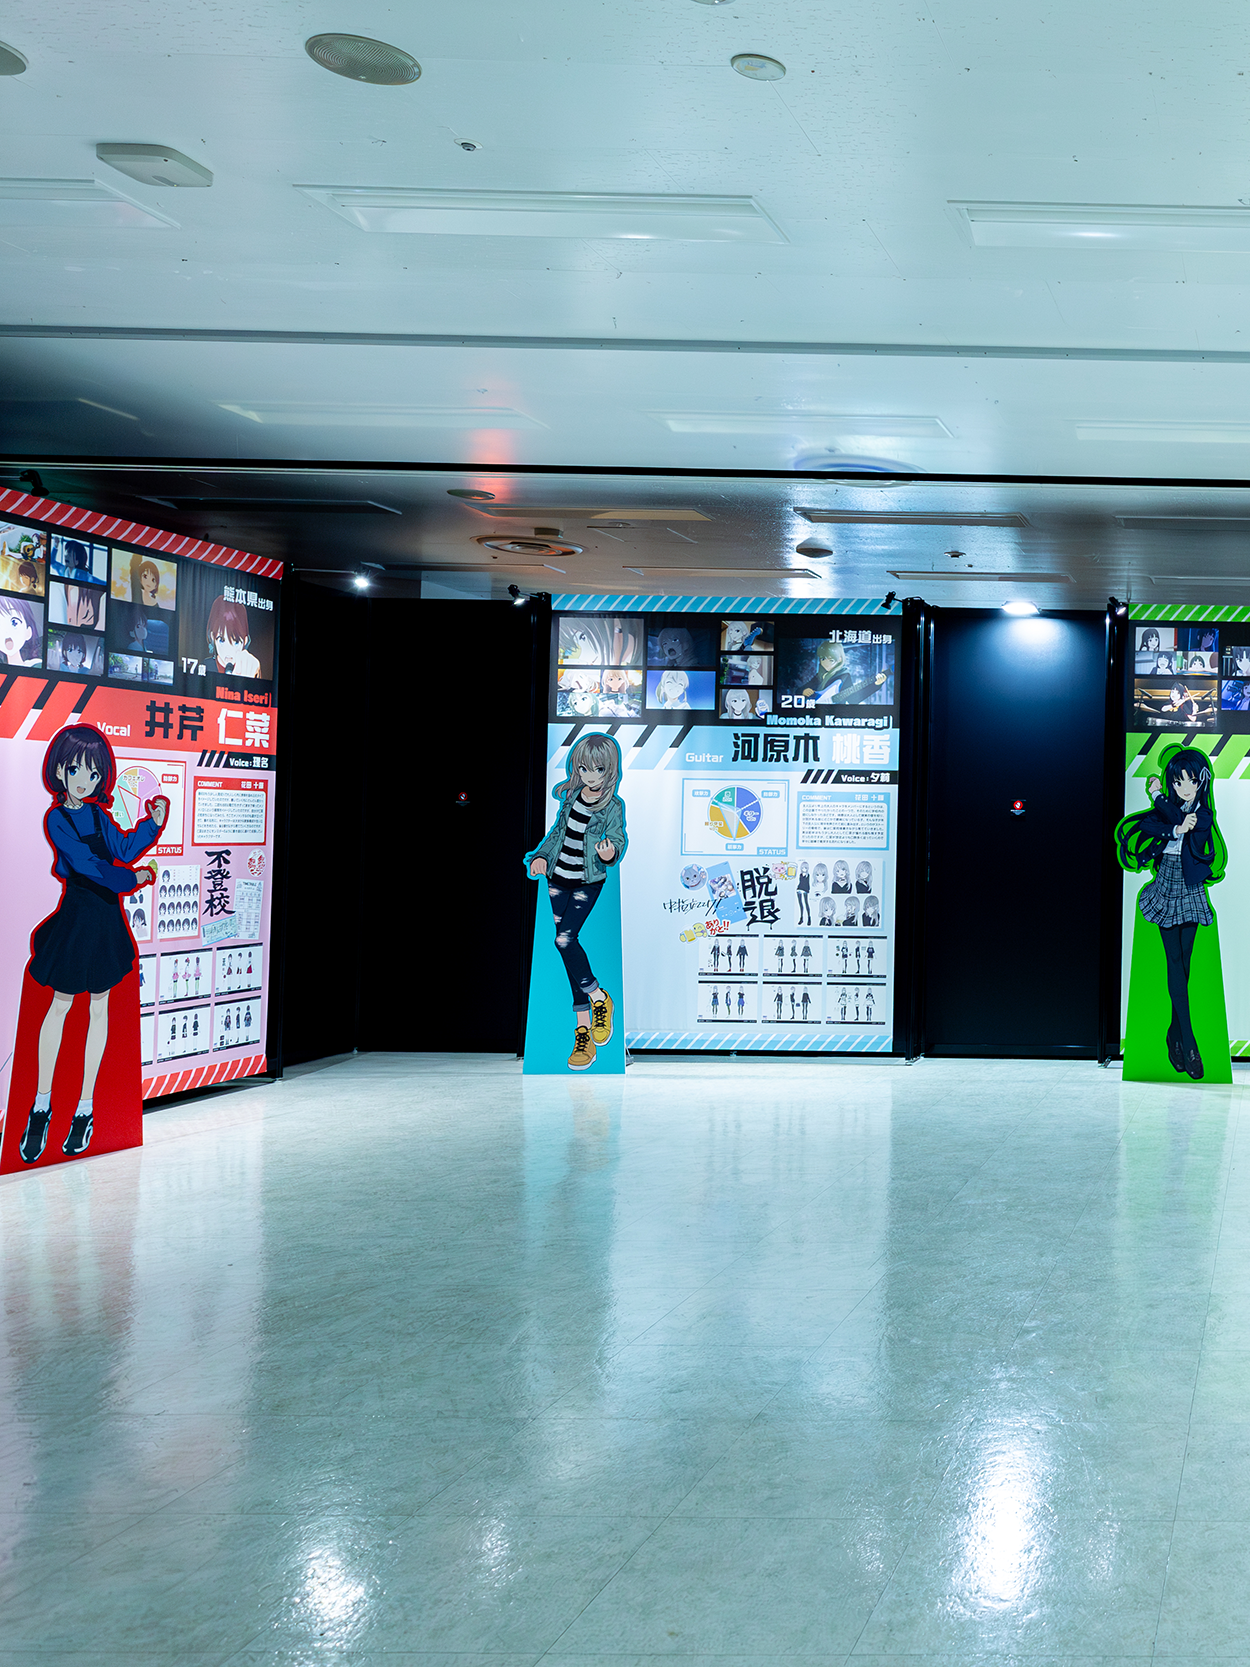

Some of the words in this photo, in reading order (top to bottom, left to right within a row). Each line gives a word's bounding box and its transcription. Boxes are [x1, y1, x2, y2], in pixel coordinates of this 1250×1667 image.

[223, 585, 274, 612] 熊本県出身
[829, 630, 893, 645] 北海道出身
[215, 686, 241, 702] Nina
[243, 689, 269, 705] Iseri
[781, 695, 816, 709] 20歳
[97, 721, 131, 737] Vocal
[145, 700, 205, 742] 井芹
[217, 708, 271, 748] 仁菜
[766, 715, 822, 726] Momoka
[825, 715, 888, 729] Kawaragi
[685, 752, 724, 763] Guitar
[732, 733, 821, 763] 河原木
[832, 733, 891, 765] 桃香
[158, 846, 183, 854] STATUS
[202, 849, 236, 917] 不登校
[739, 867, 781, 931] 脱退
